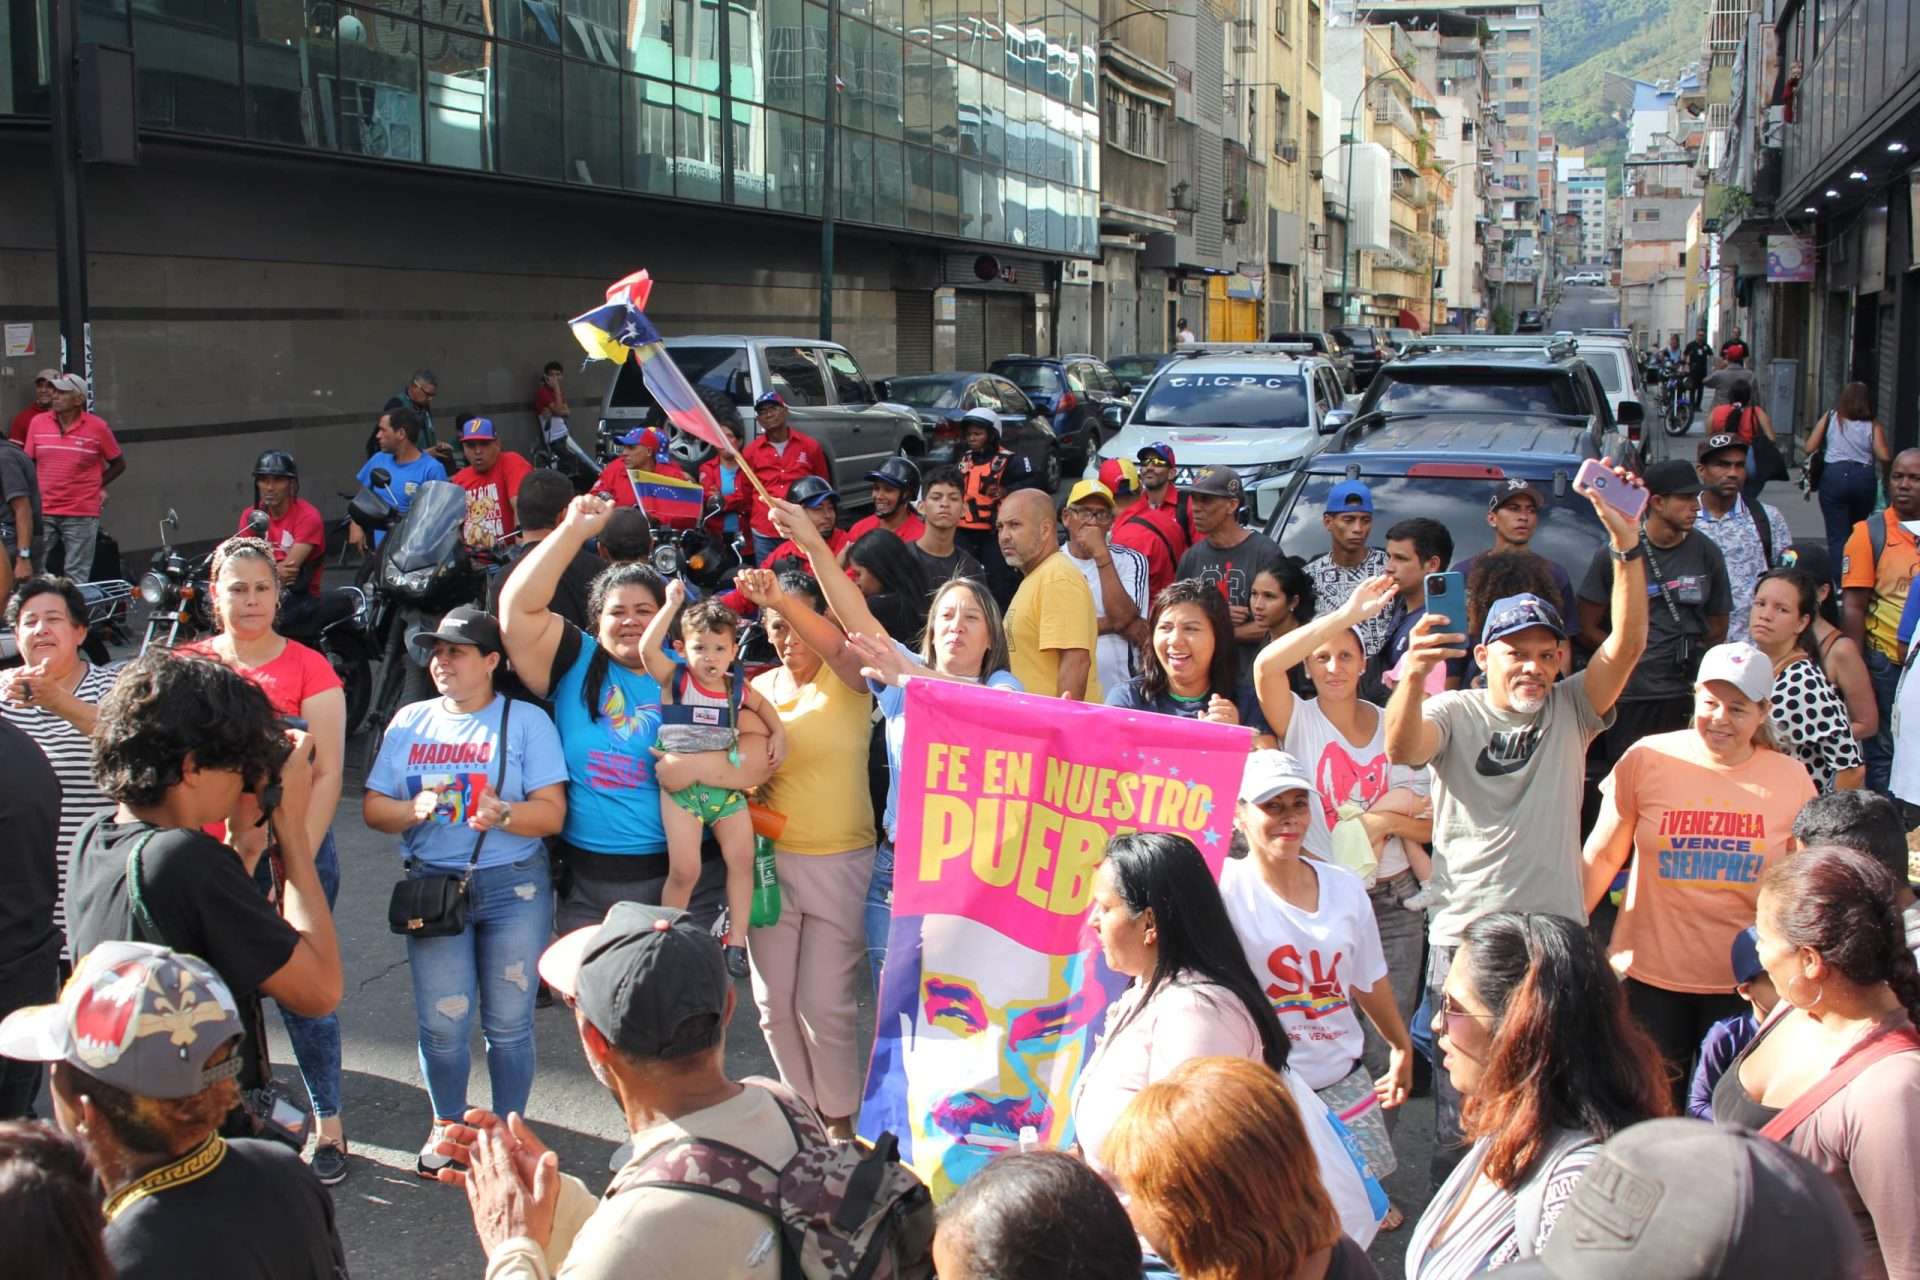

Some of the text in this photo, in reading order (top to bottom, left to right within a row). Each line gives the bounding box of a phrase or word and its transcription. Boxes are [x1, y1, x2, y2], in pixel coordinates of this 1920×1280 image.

[408, 742, 490, 765] MADURO
[926, 743, 1213, 831] FE EN NUESTRO
[918, 793, 1194, 915] PUEB
[1670, 838, 1751, 851] VENCE
[1658, 852, 1764, 882] SIEMPRE!
